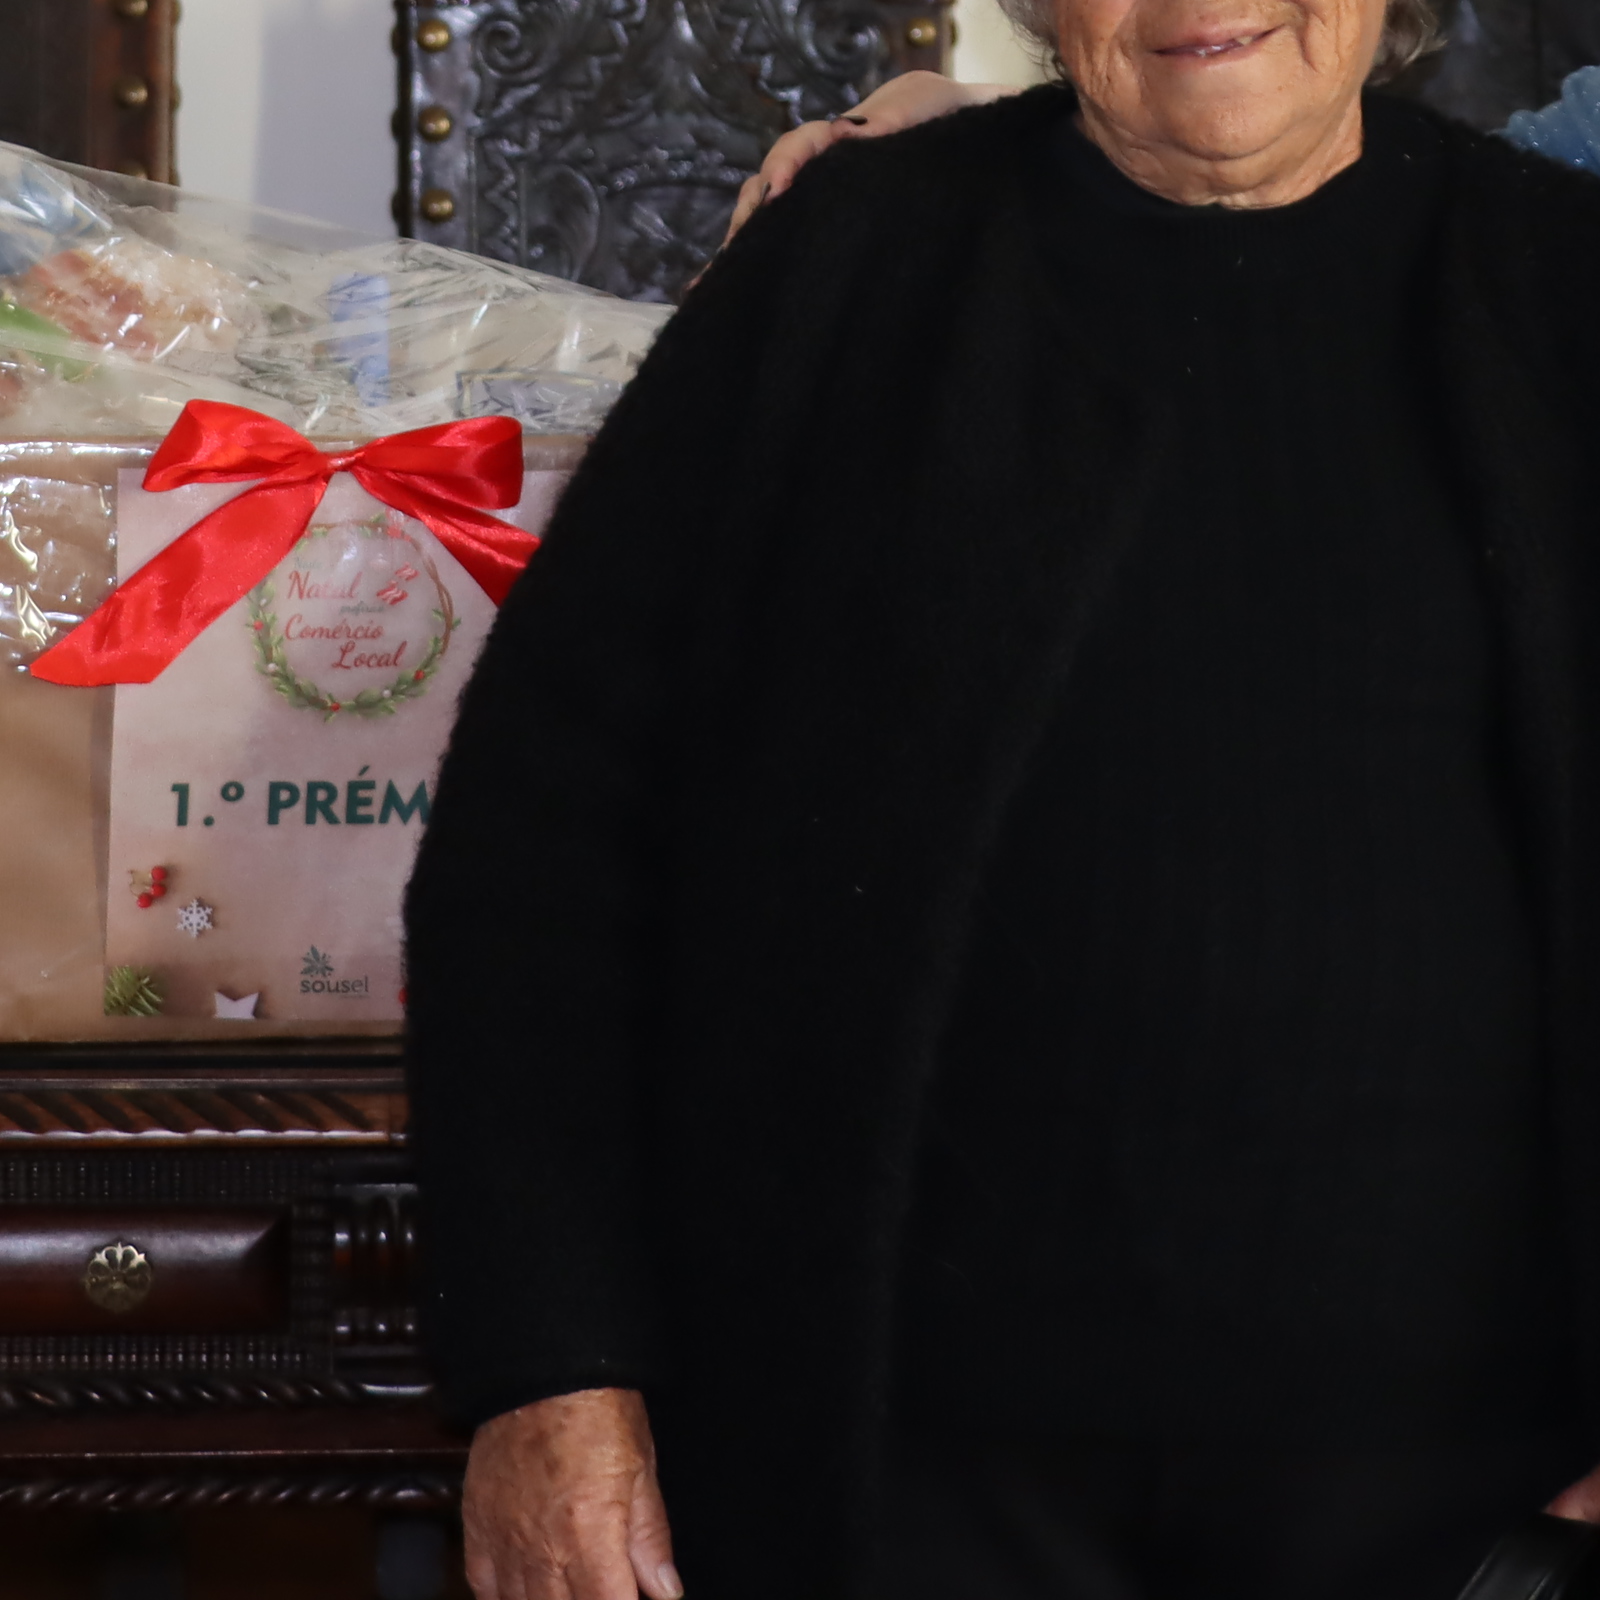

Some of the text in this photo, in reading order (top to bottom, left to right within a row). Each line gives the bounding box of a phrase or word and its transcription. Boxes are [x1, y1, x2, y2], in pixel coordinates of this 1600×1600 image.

[285, 613, 384, 640] Comércio
[331, 640, 408, 670] Local
[267, 765, 432, 826] PRÉM
[300, 976, 370, 994] sousel
